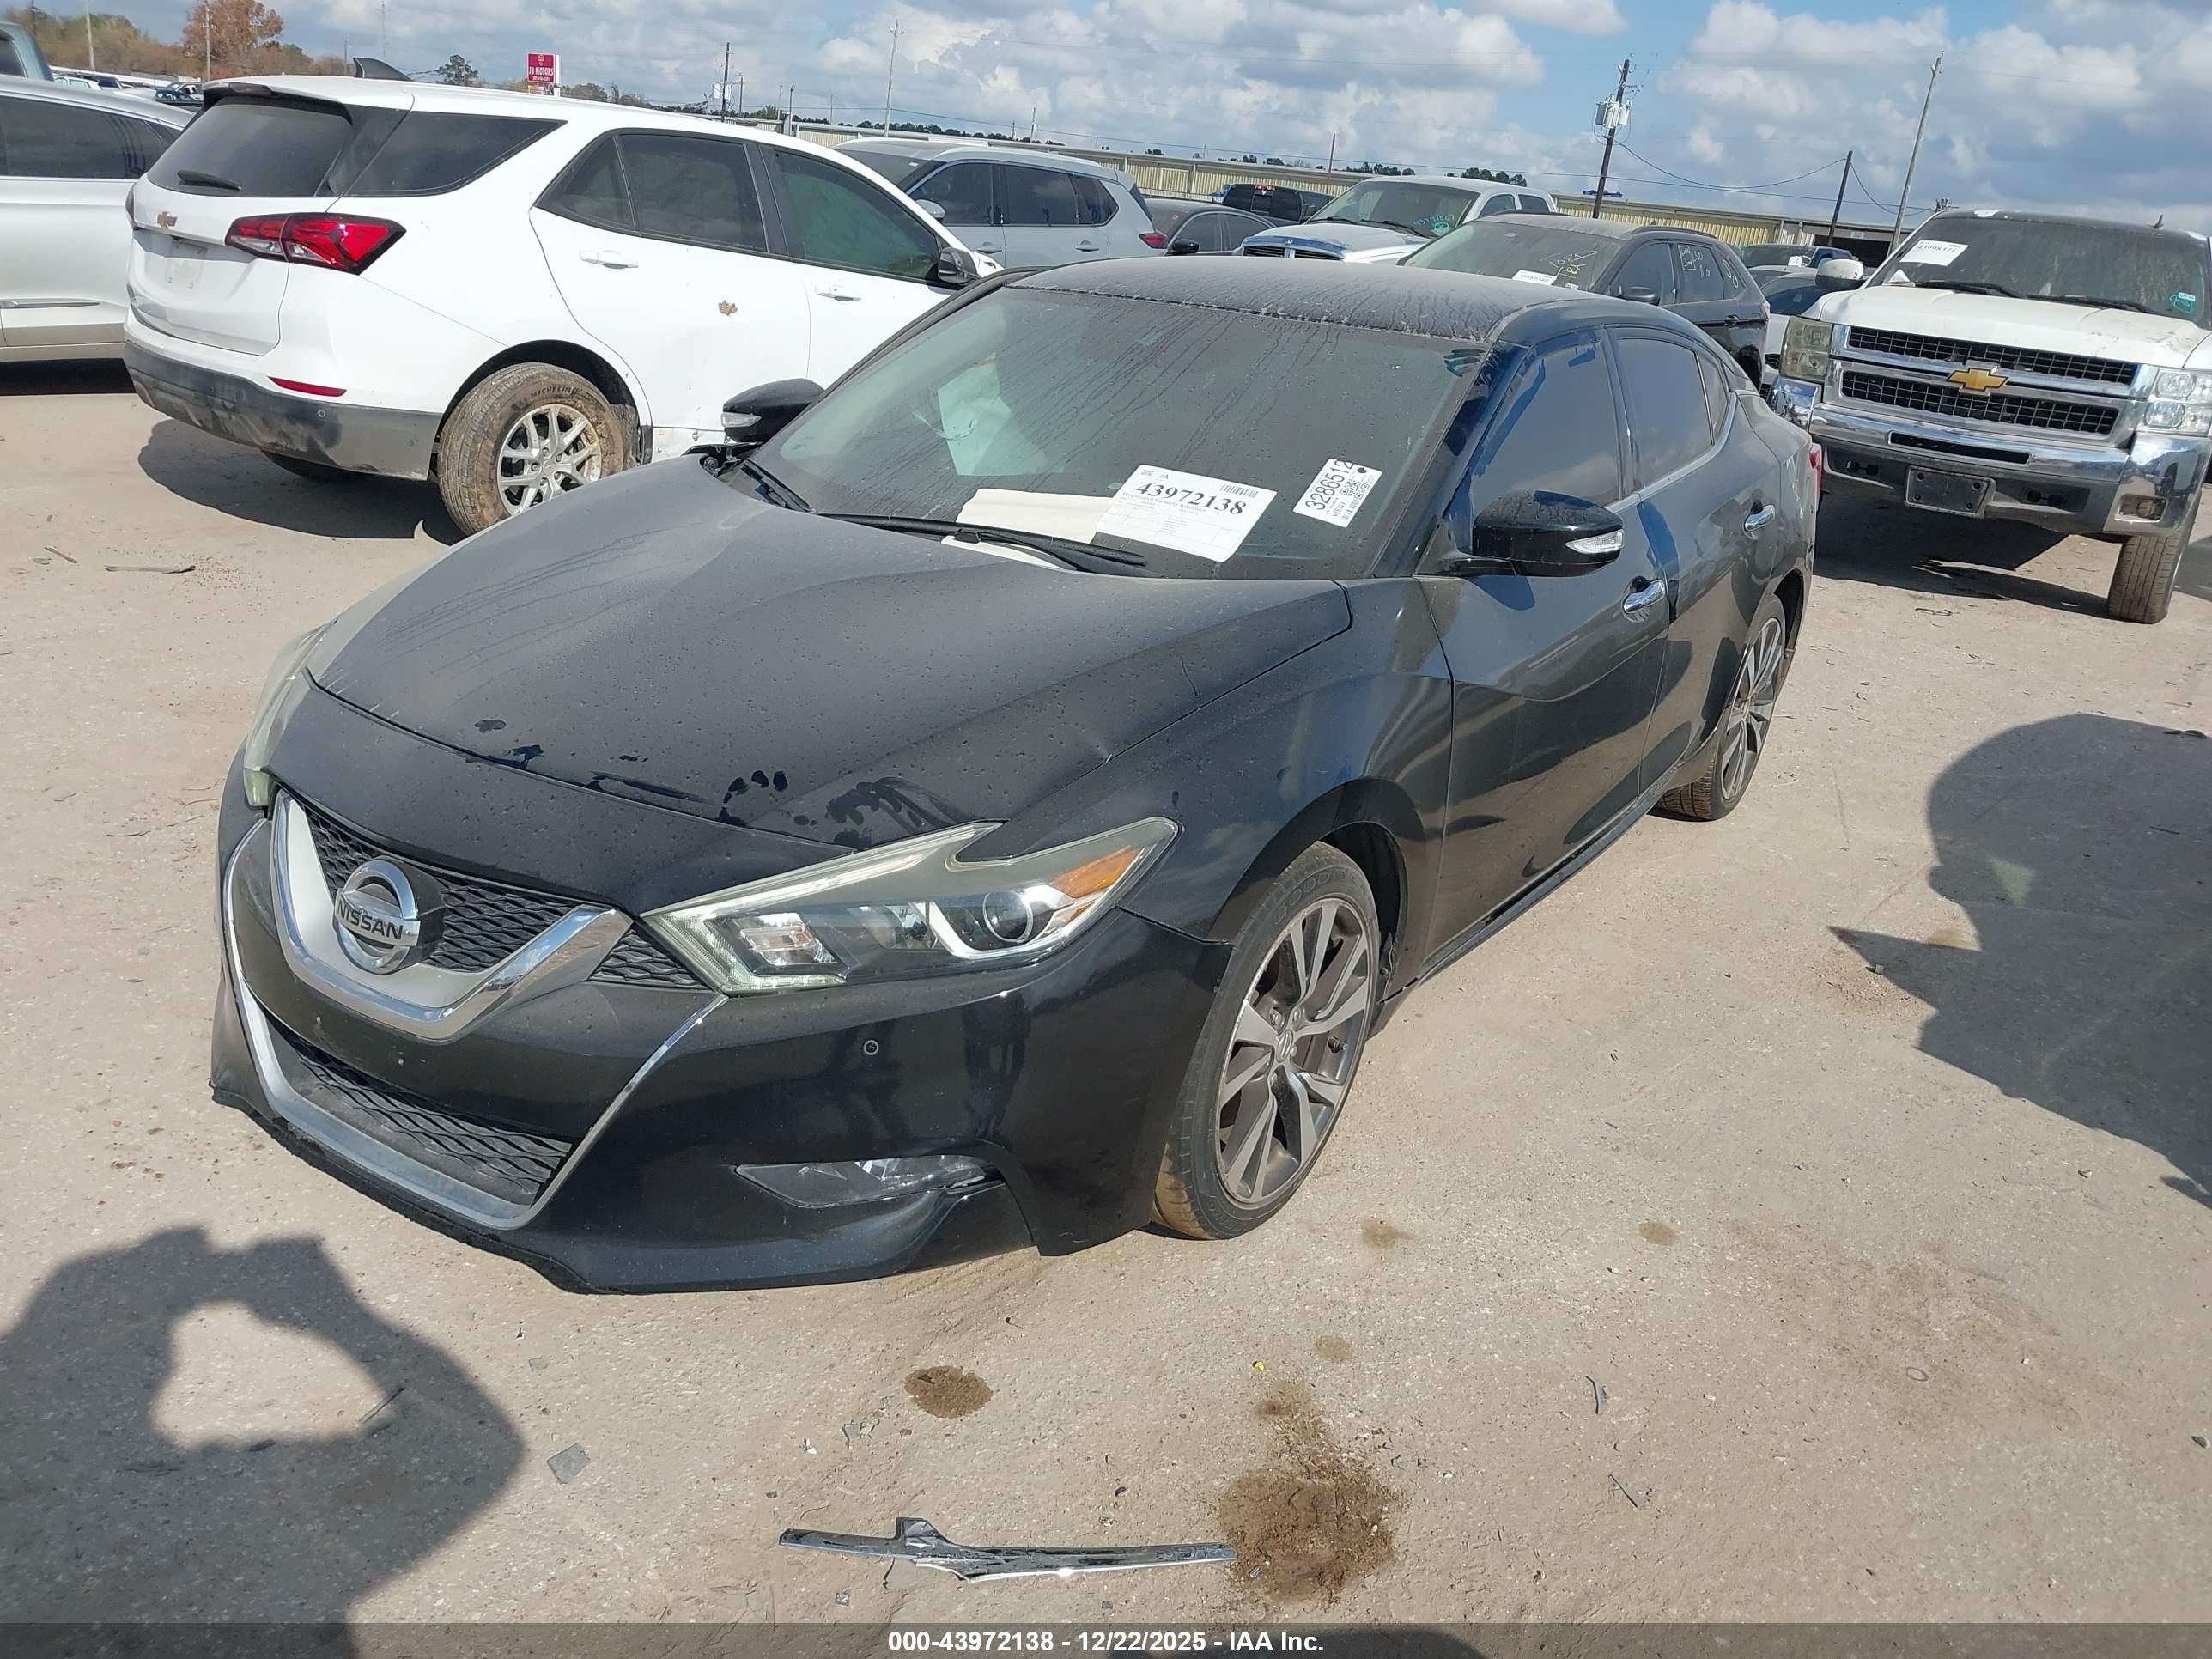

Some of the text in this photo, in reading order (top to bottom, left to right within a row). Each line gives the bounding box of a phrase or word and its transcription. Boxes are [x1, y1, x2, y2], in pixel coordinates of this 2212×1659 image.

[1136, 483, 1246, 515] 43972138
[1305, 459, 1354, 510] 3286512
[337, 900, 403, 940] NISSAN
